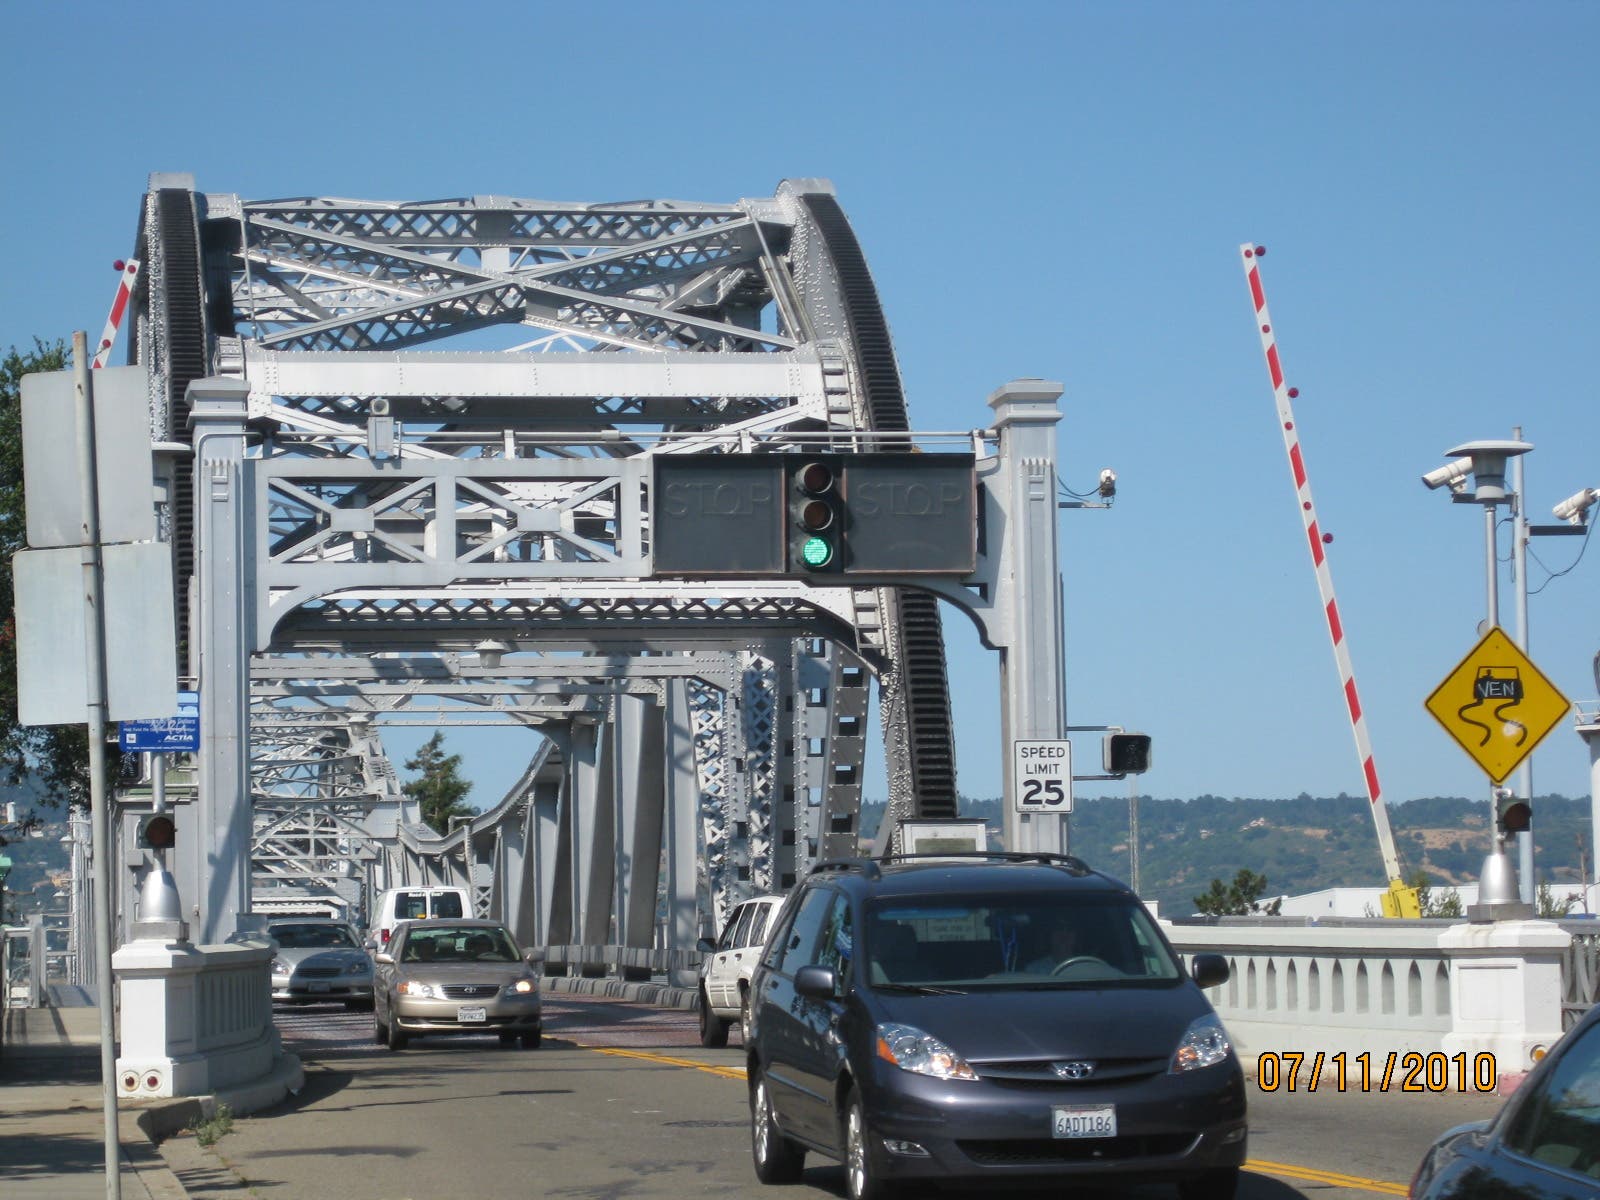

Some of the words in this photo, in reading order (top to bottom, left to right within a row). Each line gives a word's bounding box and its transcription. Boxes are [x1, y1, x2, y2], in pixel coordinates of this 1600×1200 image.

[664, 481, 770, 516] STOP
[855, 481, 963, 516] STOP
[1477, 680, 1515, 698] VEN
[1020, 746, 1066, 759] SPEED
[1025, 763, 1061, 775] LIMIT
[1022, 778, 1065, 806] 25
[1057, 1116, 1112, 1133] 6ADT186
